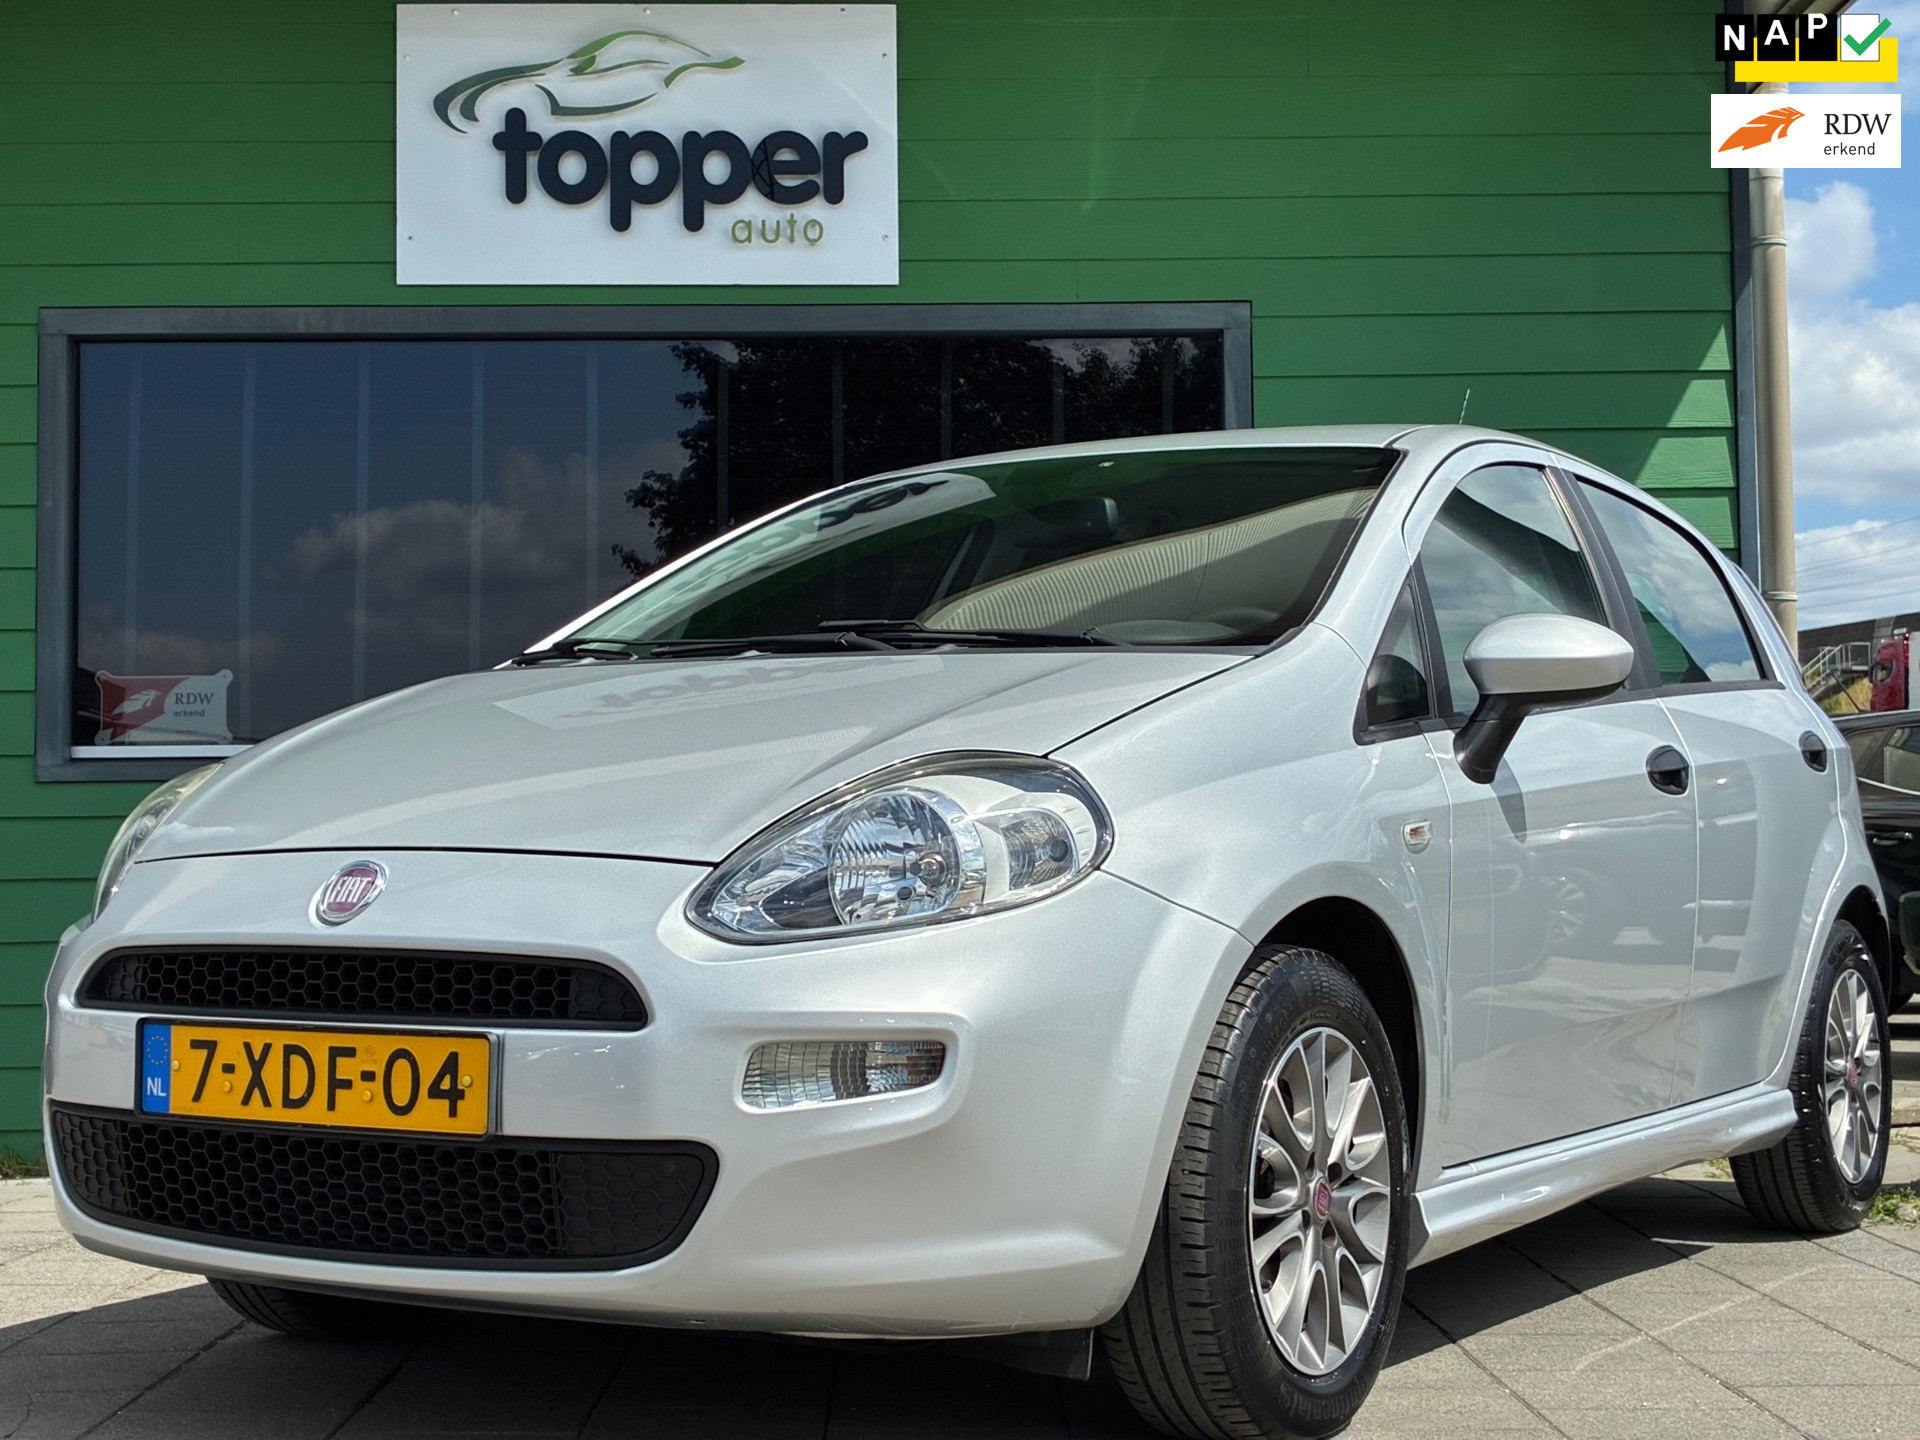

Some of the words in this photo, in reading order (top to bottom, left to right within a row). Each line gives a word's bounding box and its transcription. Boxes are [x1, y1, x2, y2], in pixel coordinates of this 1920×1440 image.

[492, 107, 869, 233] topper
[731, 213, 824, 246] auto
[174, 692, 214, 705] RDW
[173, 709, 205, 717] erkend
[328, 876, 372, 903] FIAT
[147, 1076, 167, 1098] NL
[189, 1038, 466, 1119] 7-XDF-04
